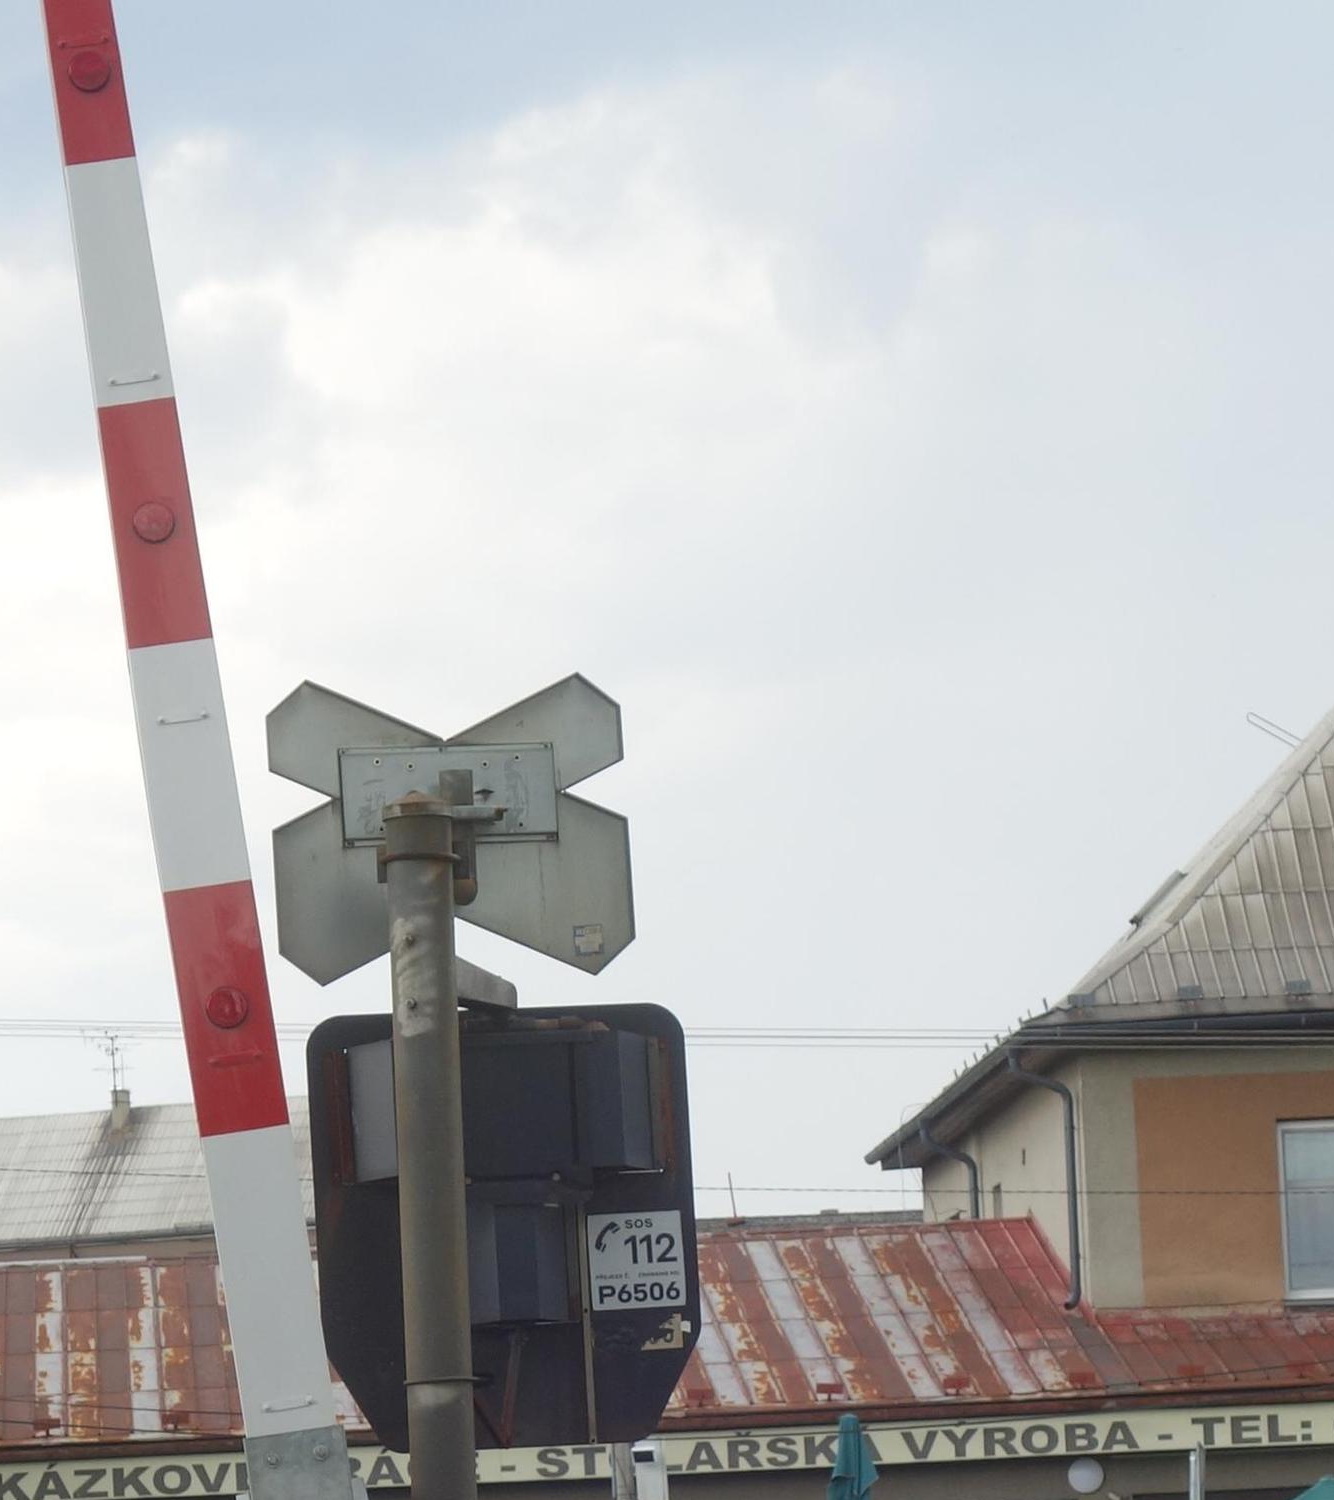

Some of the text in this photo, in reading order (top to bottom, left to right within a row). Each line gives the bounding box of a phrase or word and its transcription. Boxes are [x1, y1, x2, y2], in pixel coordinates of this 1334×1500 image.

[624, 1218, 653, 1229] SOS
[624, 1233, 678, 1264] 112
[598, 1281, 680, 1305] P6506
[1192, 1414, 1313, 1446] TEL:
